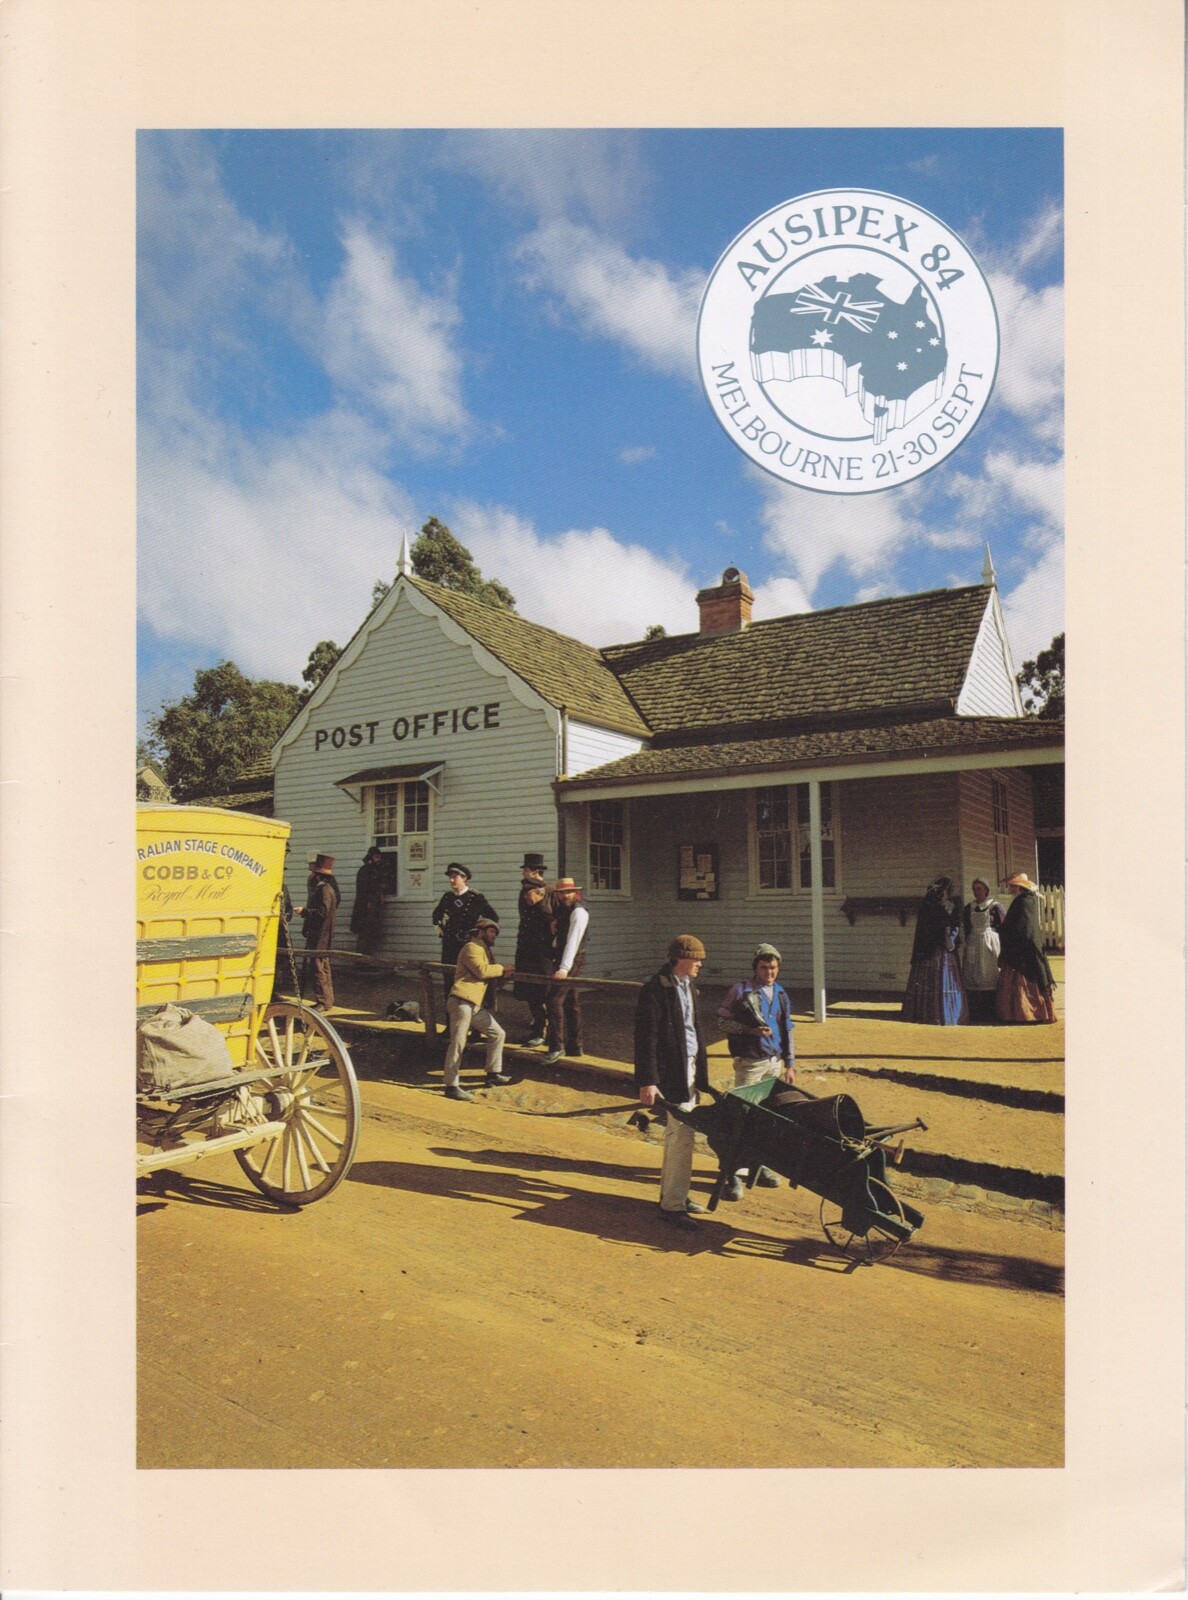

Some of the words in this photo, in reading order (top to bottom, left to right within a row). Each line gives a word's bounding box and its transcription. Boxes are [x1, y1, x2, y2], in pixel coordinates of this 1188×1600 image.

[315, 721, 379, 751] POST
[392, 702, 500, 741] OFFICE
[142, 865, 199, 880] COBB
[201, 869, 211, 880] &
[184, 839, 218, 854] STAGE
[220, 844, 267, 877] COMPANY
[143, 884, 191, 907] Royal
[192, 884, 231, 900] Mail
